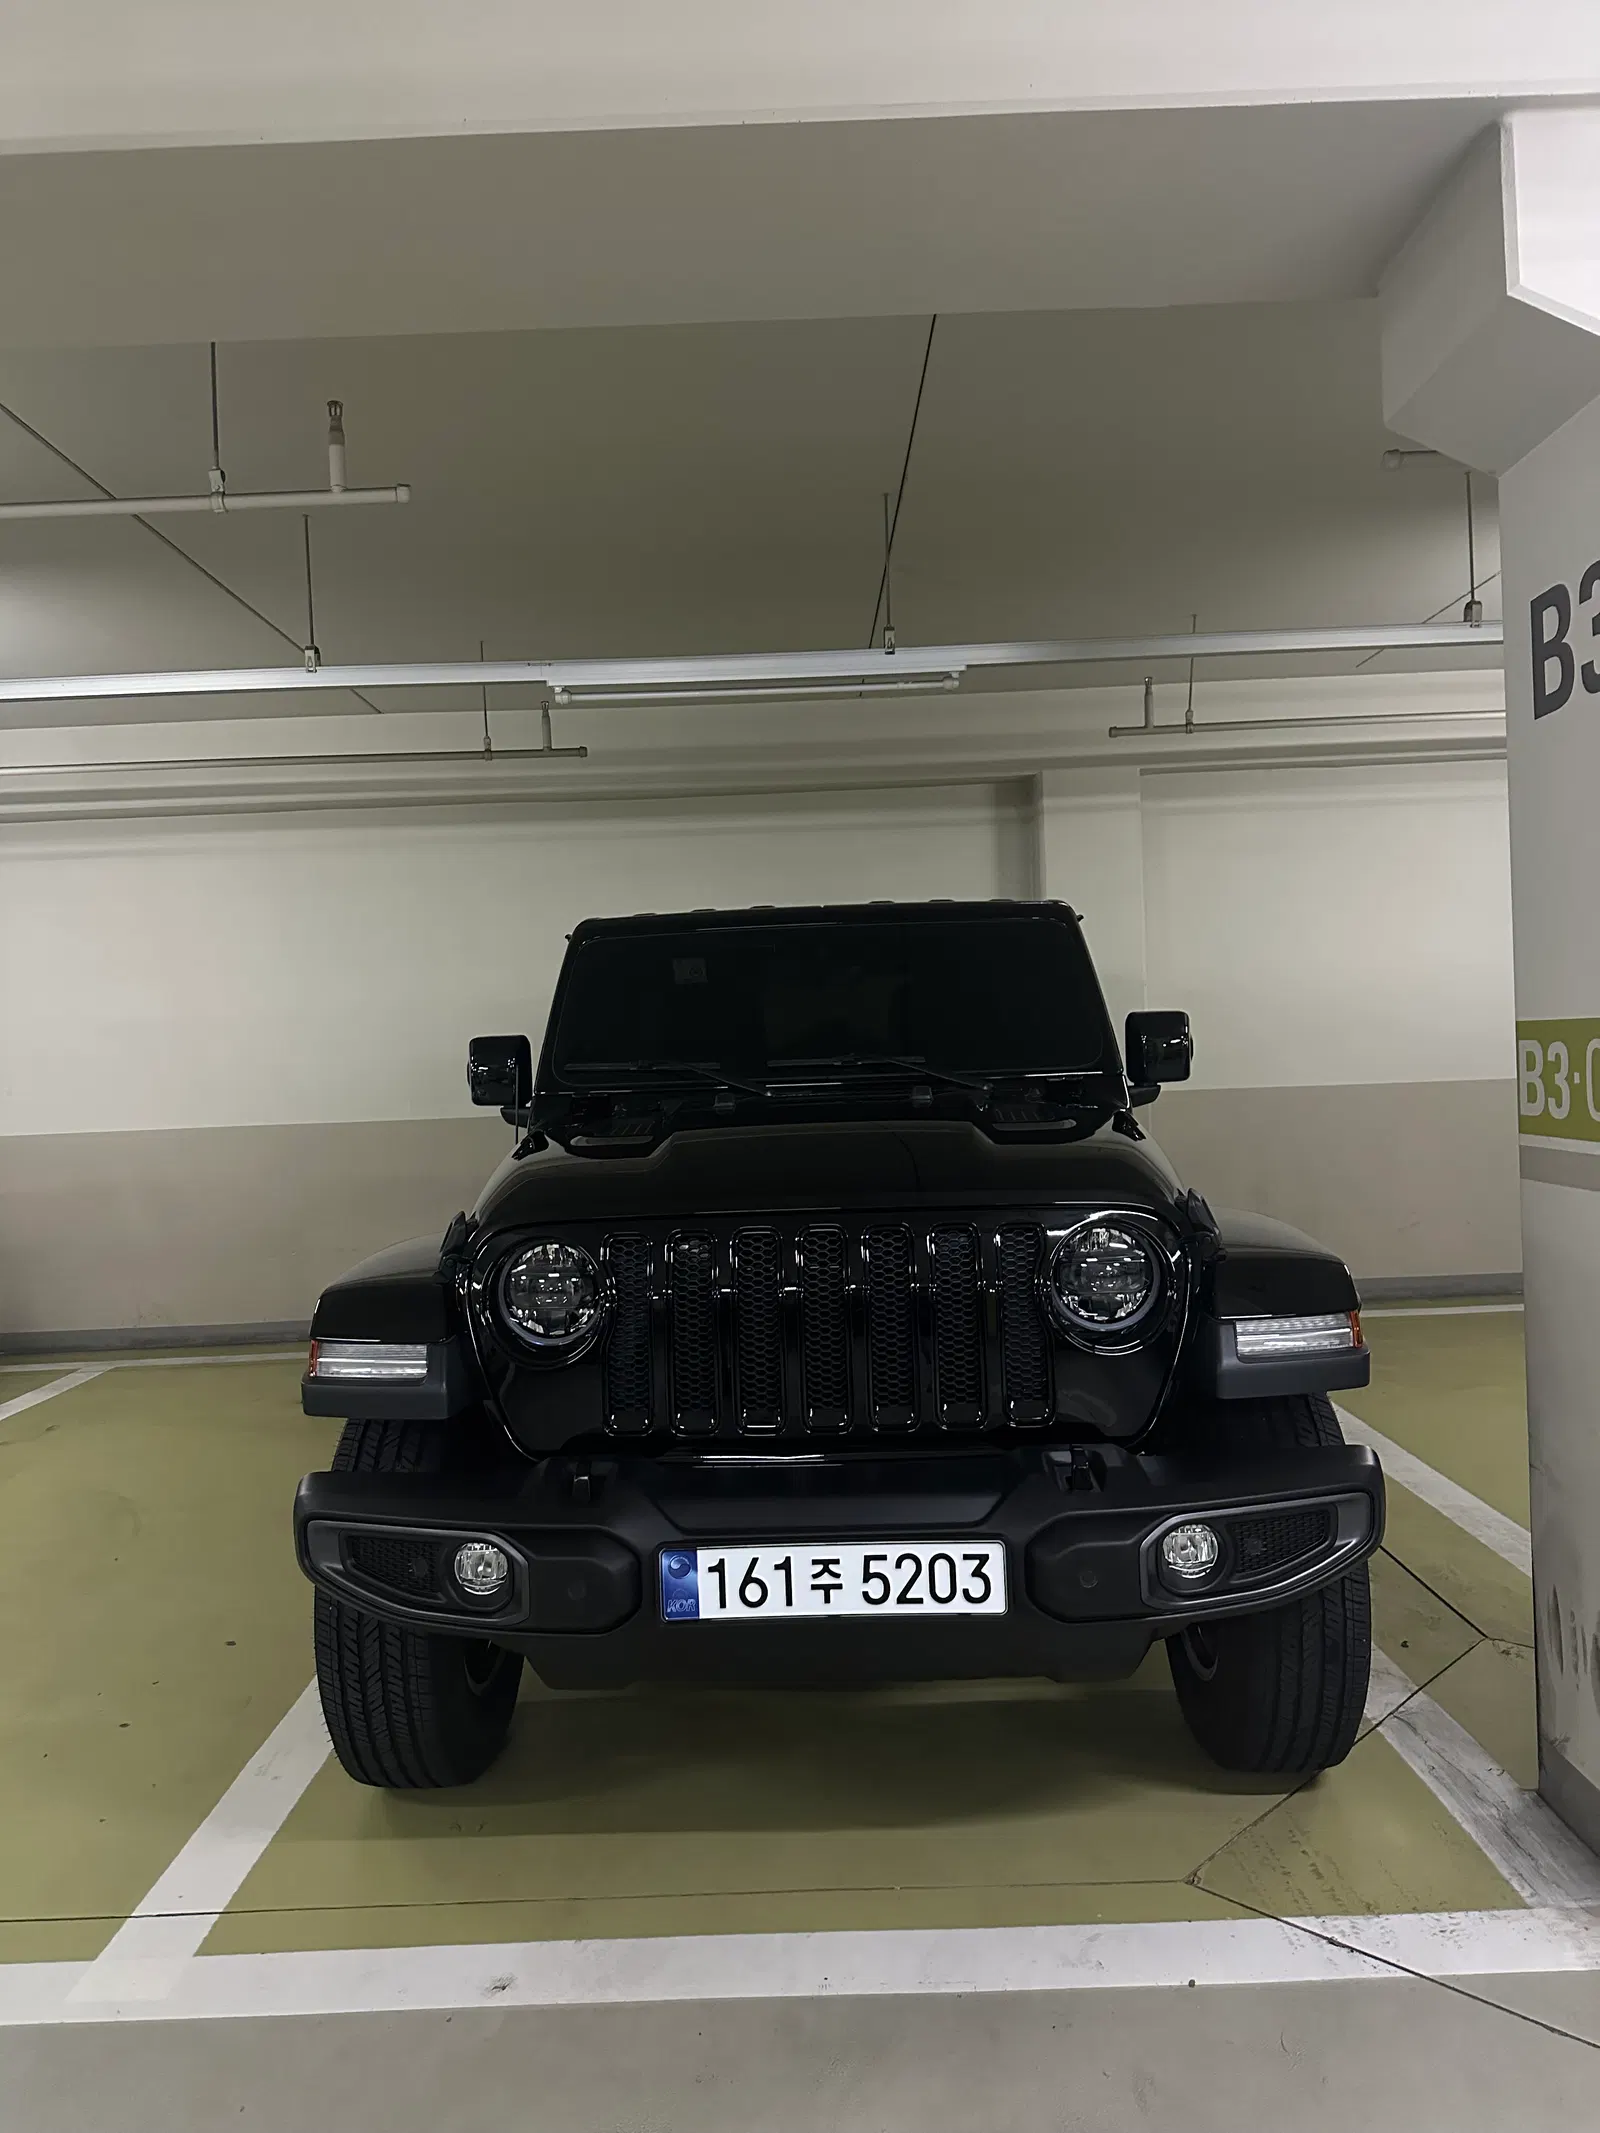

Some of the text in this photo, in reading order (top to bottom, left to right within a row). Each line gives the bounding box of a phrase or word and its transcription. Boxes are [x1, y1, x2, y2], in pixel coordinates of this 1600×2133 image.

[707, 1552, 991, 1609] 161주 5203
[666, 1597, 698, 1614] KOR
